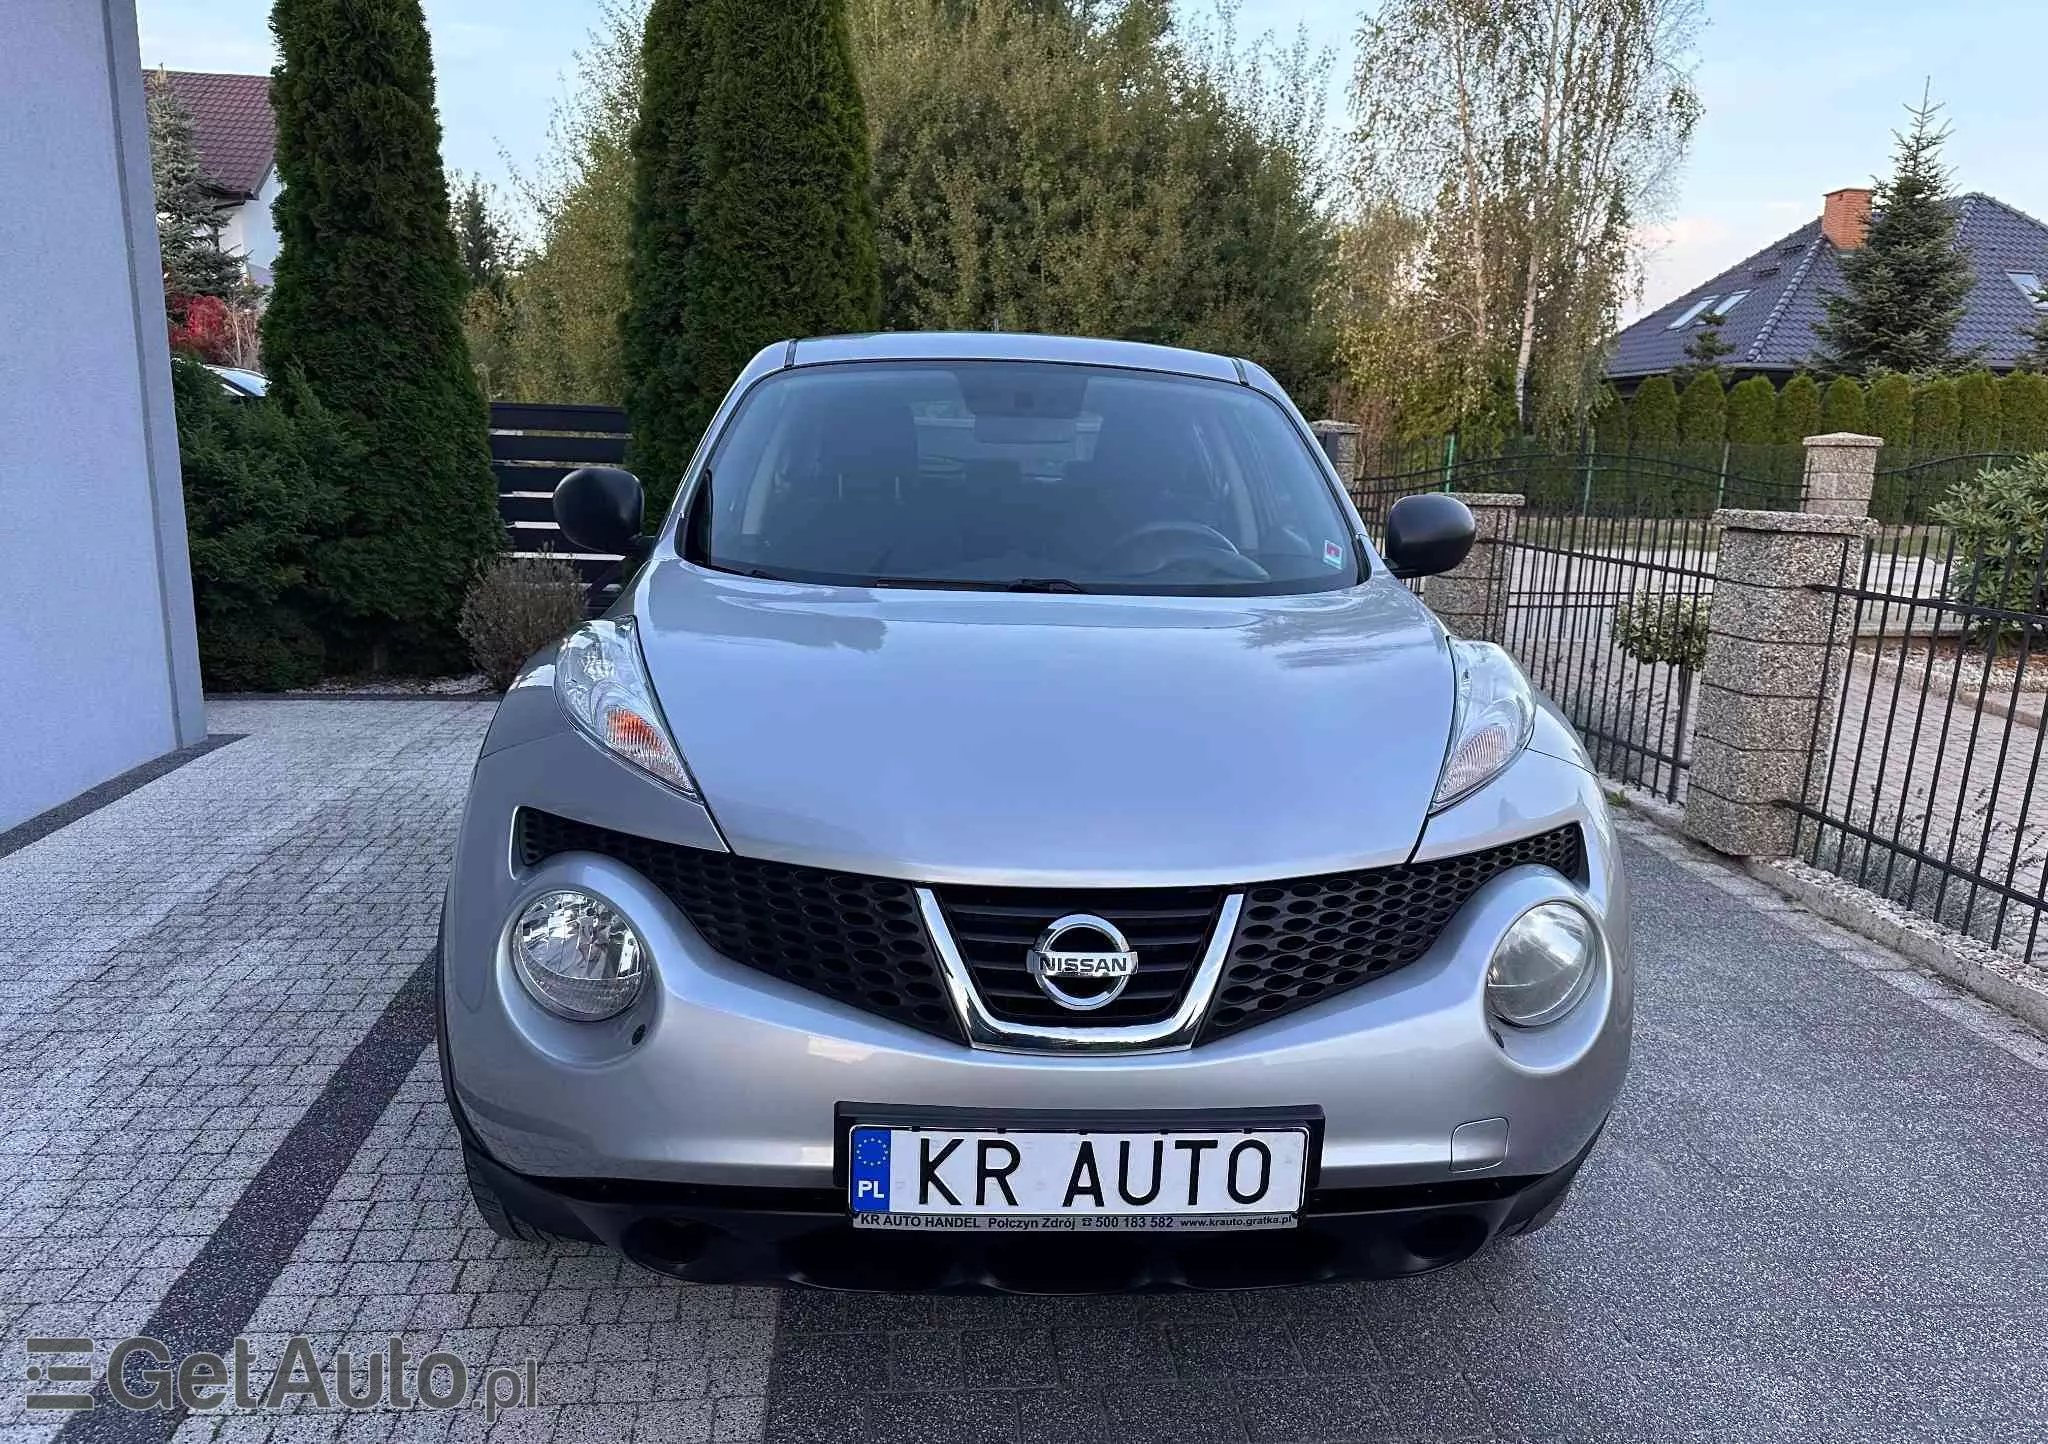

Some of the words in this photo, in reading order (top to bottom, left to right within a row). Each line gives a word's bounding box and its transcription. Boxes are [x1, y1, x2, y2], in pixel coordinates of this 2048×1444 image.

[1039, 957, 1127, 973] NISSAN
[918, 1138, 1021, 1207] KR
[1062, 1139, 1272, 1208] AUTO
[857, 1180, 885, 1199] PL
[860, 1213, 881, 1225] KR
[883, 1215, 921, 1227] AUTO
[925, 1217, 981, 1228] HANDEL
[1042, 1216, 1076, 1230] Zdrój
[1095, 1216, 1119, 1228] 500
[1124, 1216, 1146, 1228] 183
[1150, 1216, 1174, 1228] 582
